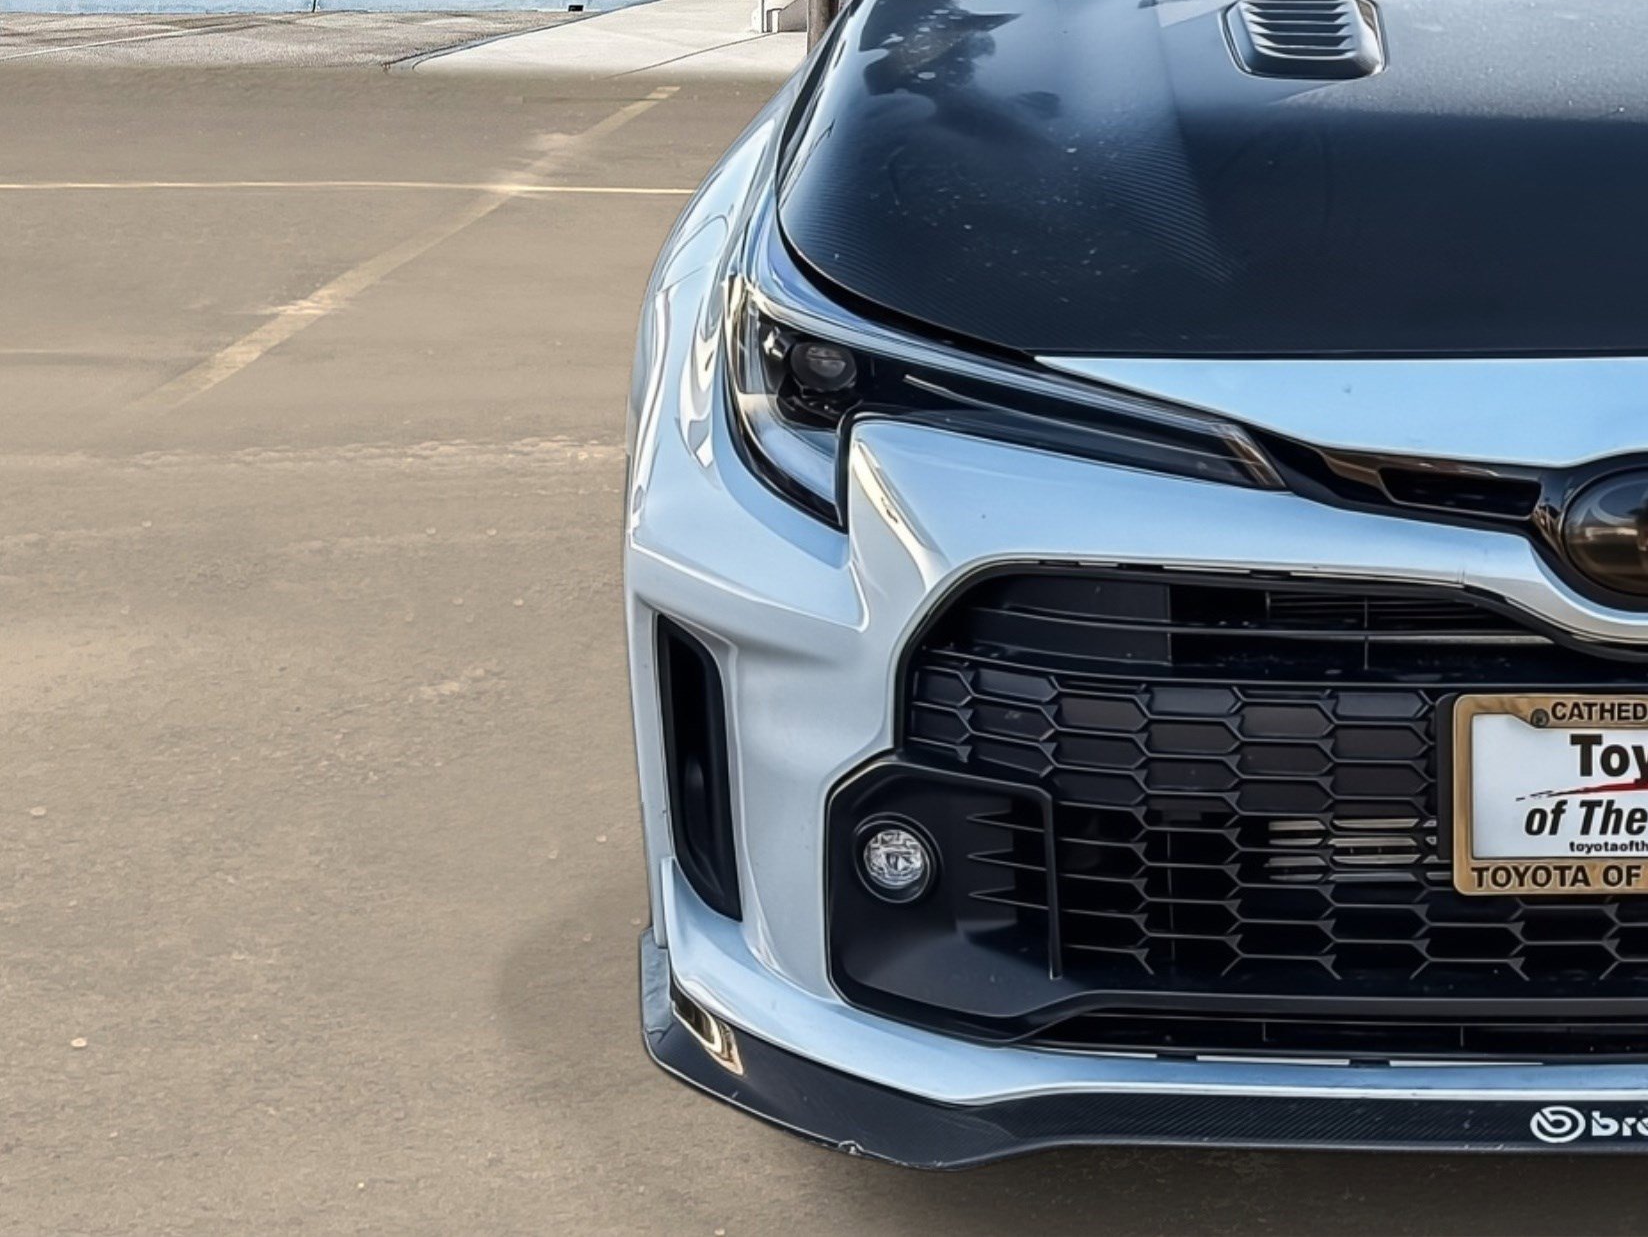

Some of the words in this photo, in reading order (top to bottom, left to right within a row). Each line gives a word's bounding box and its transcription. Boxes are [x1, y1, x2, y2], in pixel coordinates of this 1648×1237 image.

[1524, 799, 1567, 836] of
[1579, 799, 1648, 836] The
[1471, 864, 1592, 889] TOYOTA
[1602, 864, 1642, 888] OF
